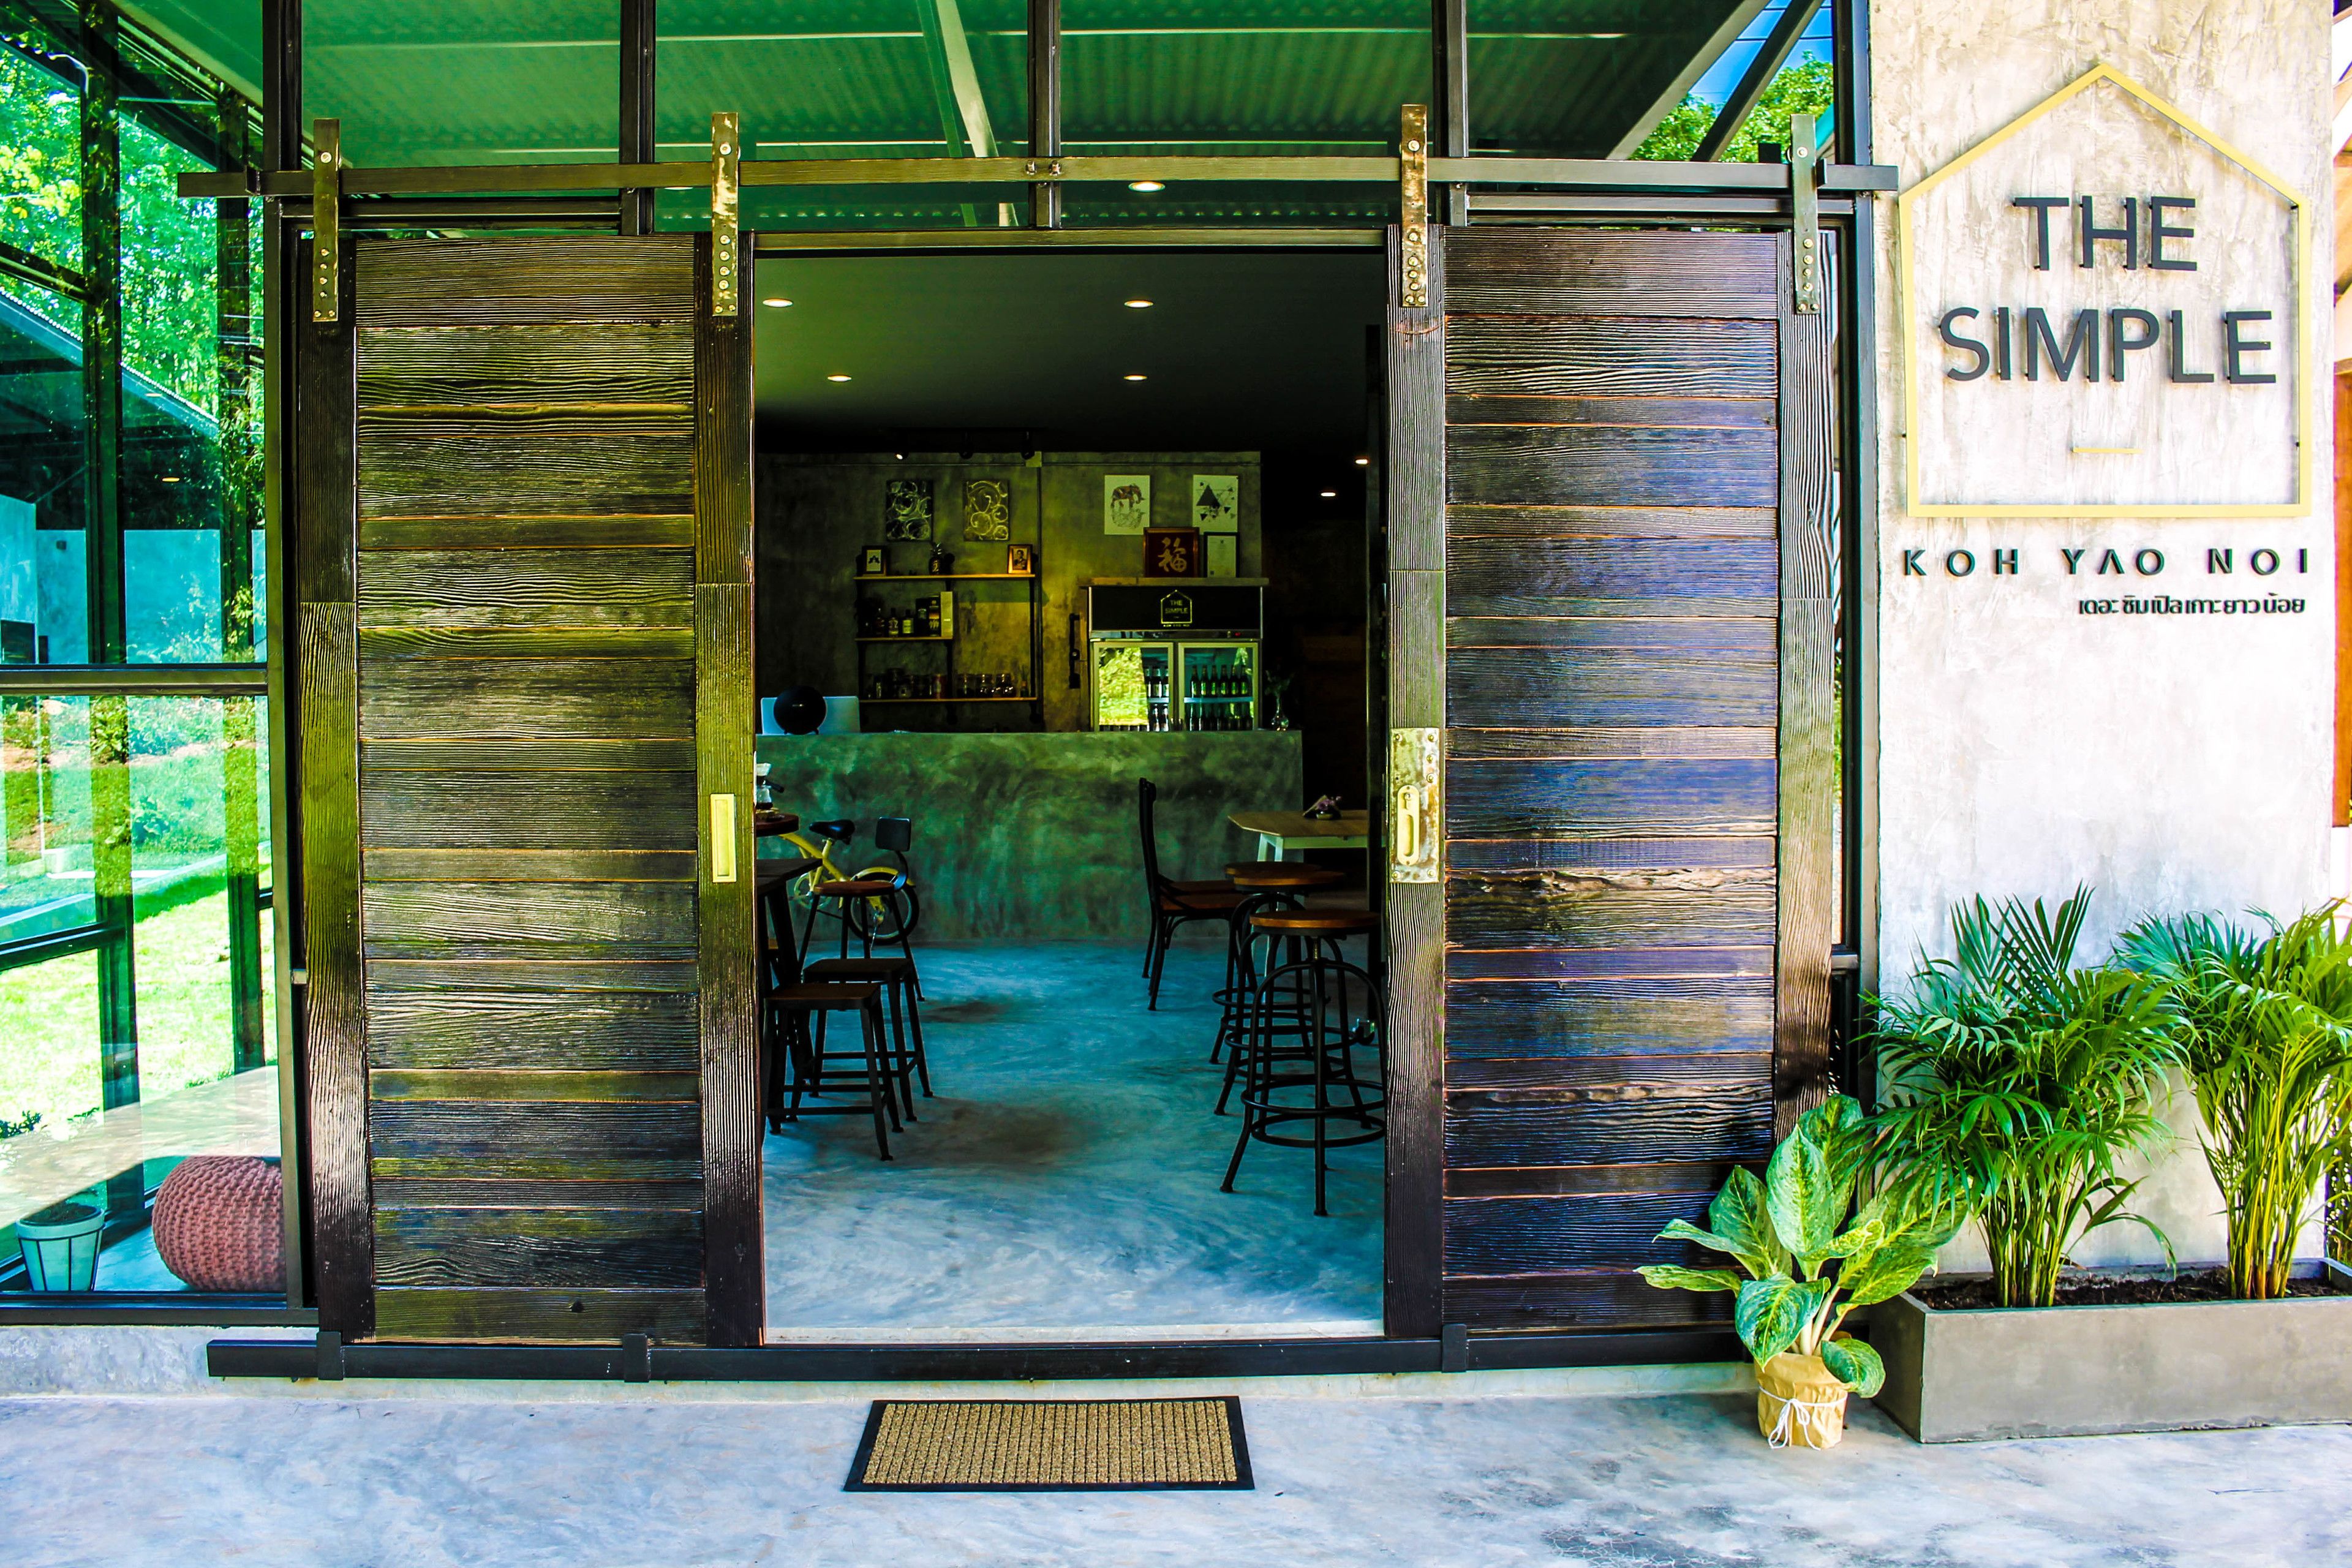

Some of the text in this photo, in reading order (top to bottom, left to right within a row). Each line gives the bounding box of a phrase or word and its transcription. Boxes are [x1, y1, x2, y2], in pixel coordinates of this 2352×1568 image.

[2012, 195, 2198, 271] THE
[1938, 307, 2277, 384] SIMPLE
[1902, 549, 2019, 577] KOH
[2207, 548, 2308, 577] NOI
